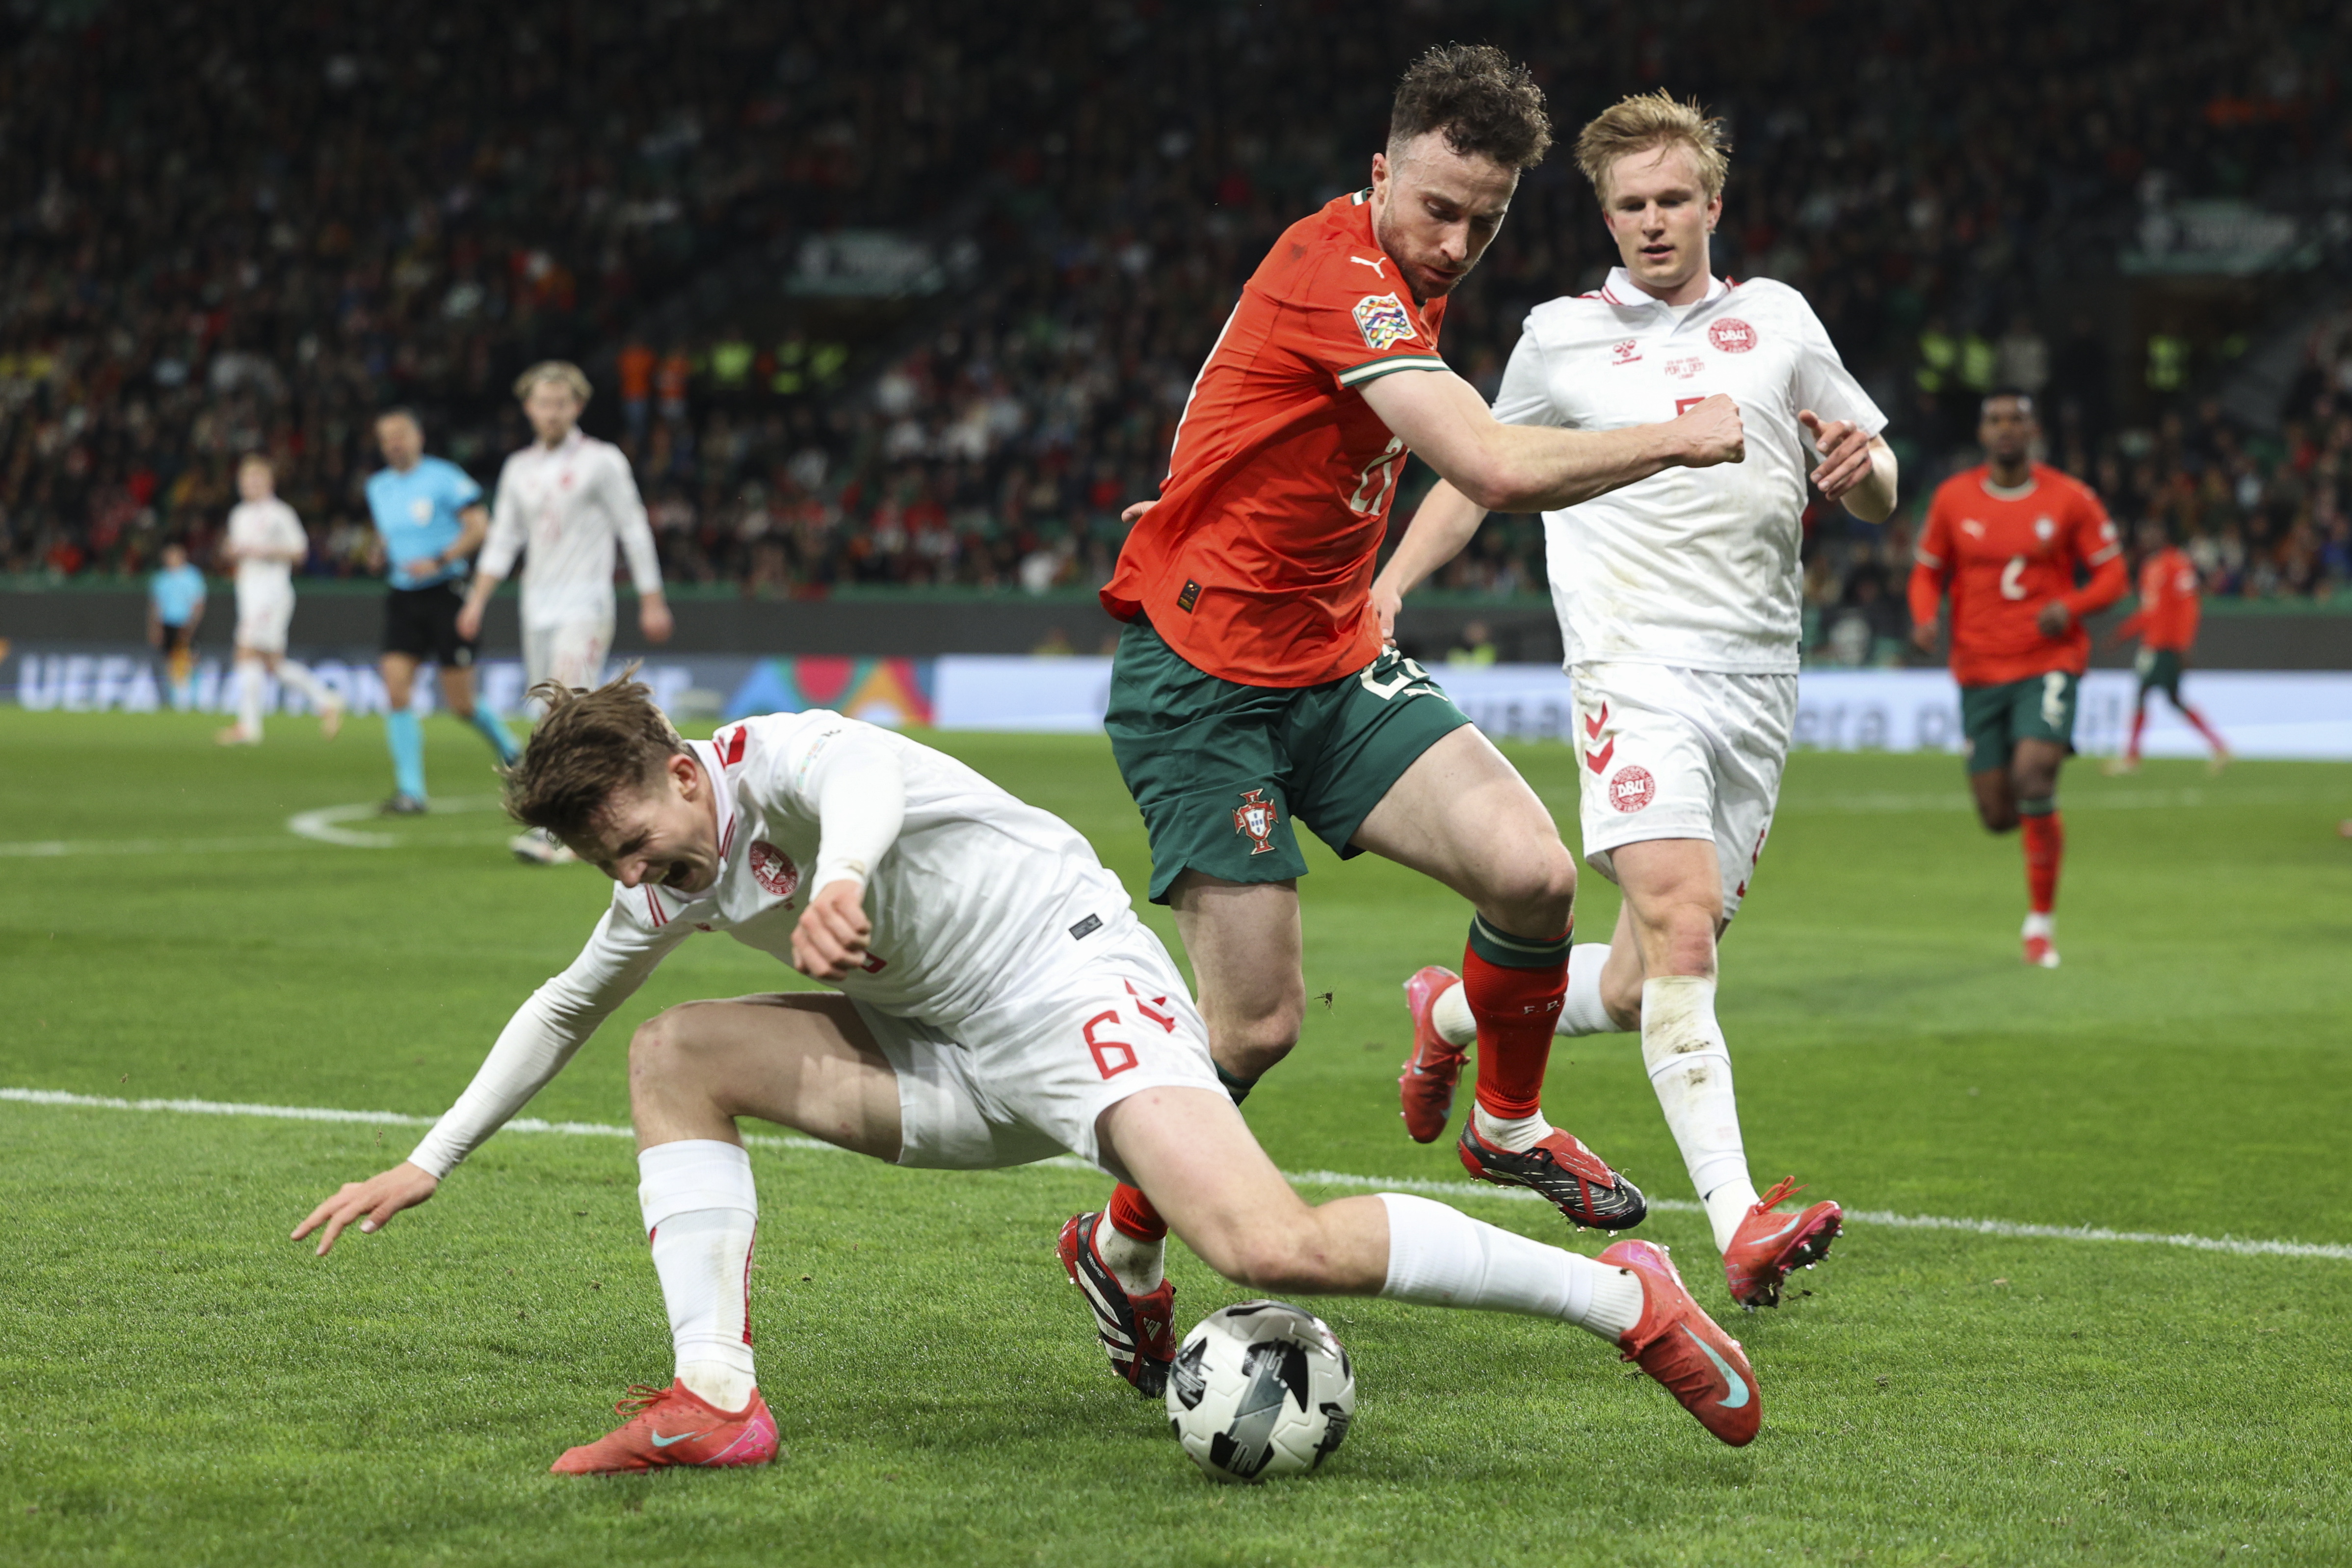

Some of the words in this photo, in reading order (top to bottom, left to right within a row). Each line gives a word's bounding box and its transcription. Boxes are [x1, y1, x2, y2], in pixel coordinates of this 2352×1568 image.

[1718, 329, 1748, 342] DBU
[1350, 435, 1411, 516] 21
[20, 654, 158, 712] UEFA
[1617, 779, 1646, 798] DBU
[1083, 1010, 1139, 1080] 6
[1087, 1252, 1107, 1279] PREDATOR
